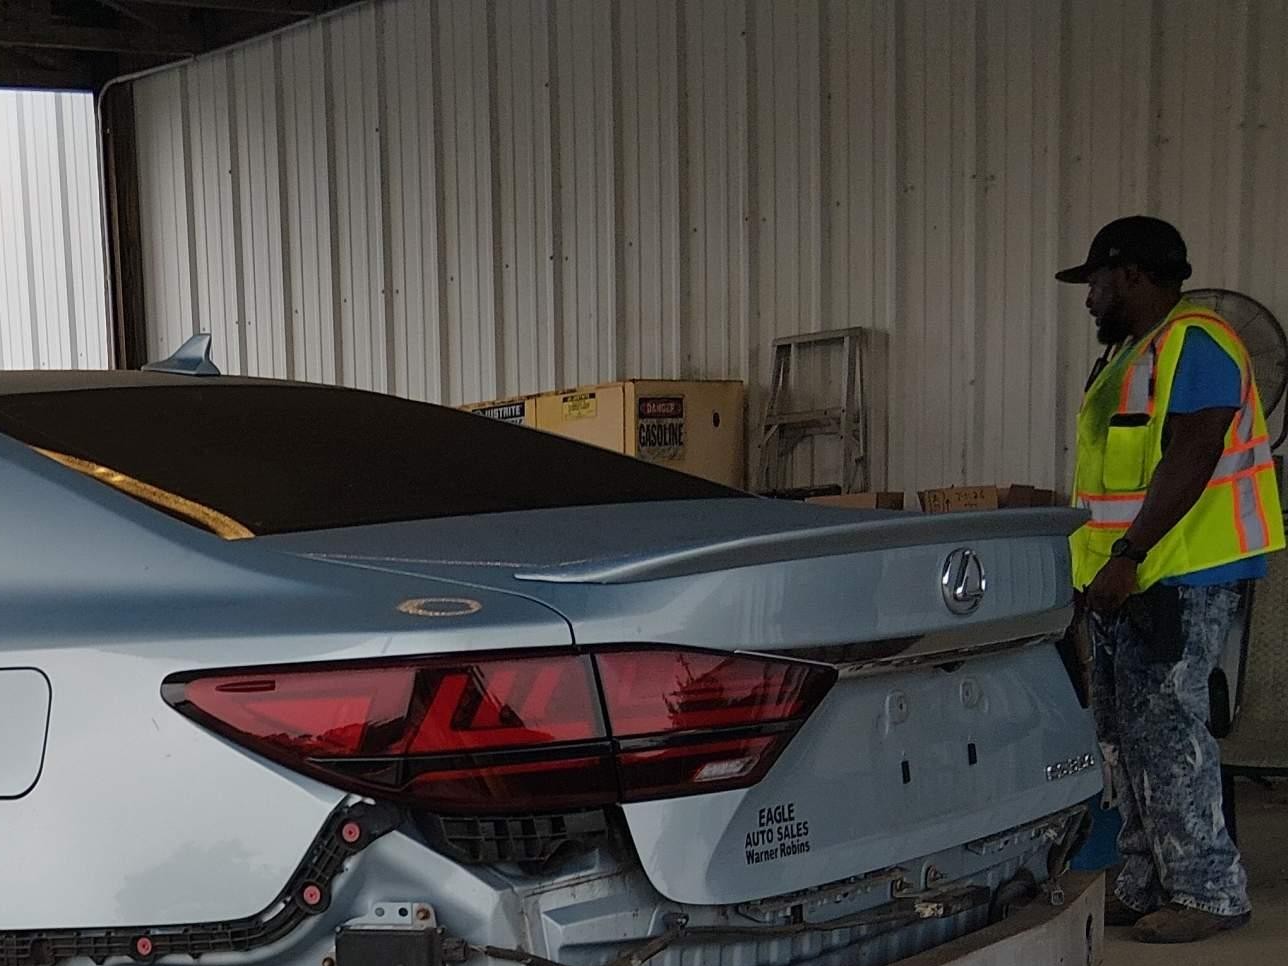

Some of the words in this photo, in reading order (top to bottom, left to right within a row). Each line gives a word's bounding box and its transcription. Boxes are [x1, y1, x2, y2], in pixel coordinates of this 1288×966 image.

[639, 422, 684, 447] GASOLINE
[759, 803, 795, 827] EAGLE
[745, 829, 773, 848] AUTO
[777, 822, 808, 841] SALES
[746, 846, 778, 864] Warner
[780, 840, 810, 858] Robins
